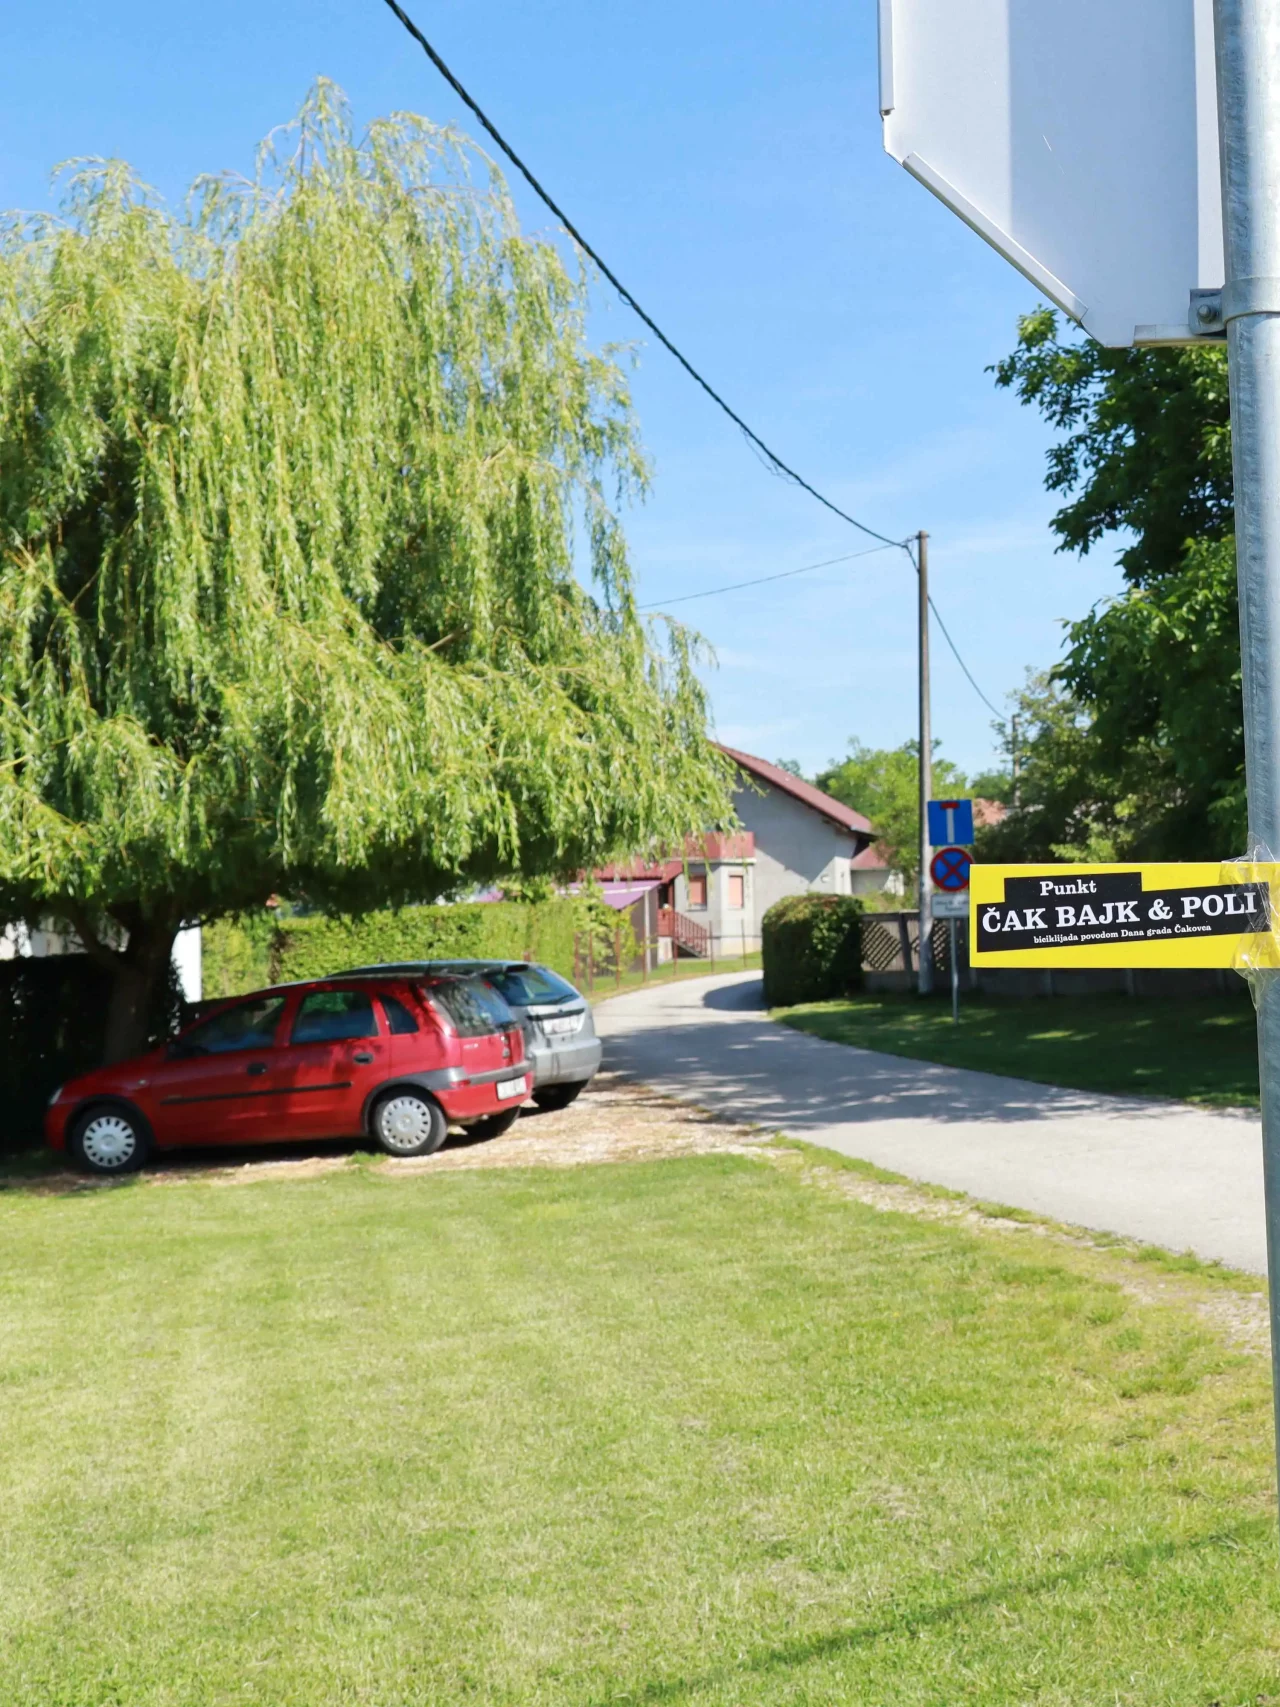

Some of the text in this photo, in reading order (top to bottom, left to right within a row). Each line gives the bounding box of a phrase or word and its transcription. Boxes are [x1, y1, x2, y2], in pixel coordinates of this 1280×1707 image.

[1039, 879, 1098, 896] Punkt
[982, 892, 1257, 933] ČAK BAJK & POLI
[1033, 923, 1212, 944] biciklijada povodom Dana grada Čakovca
